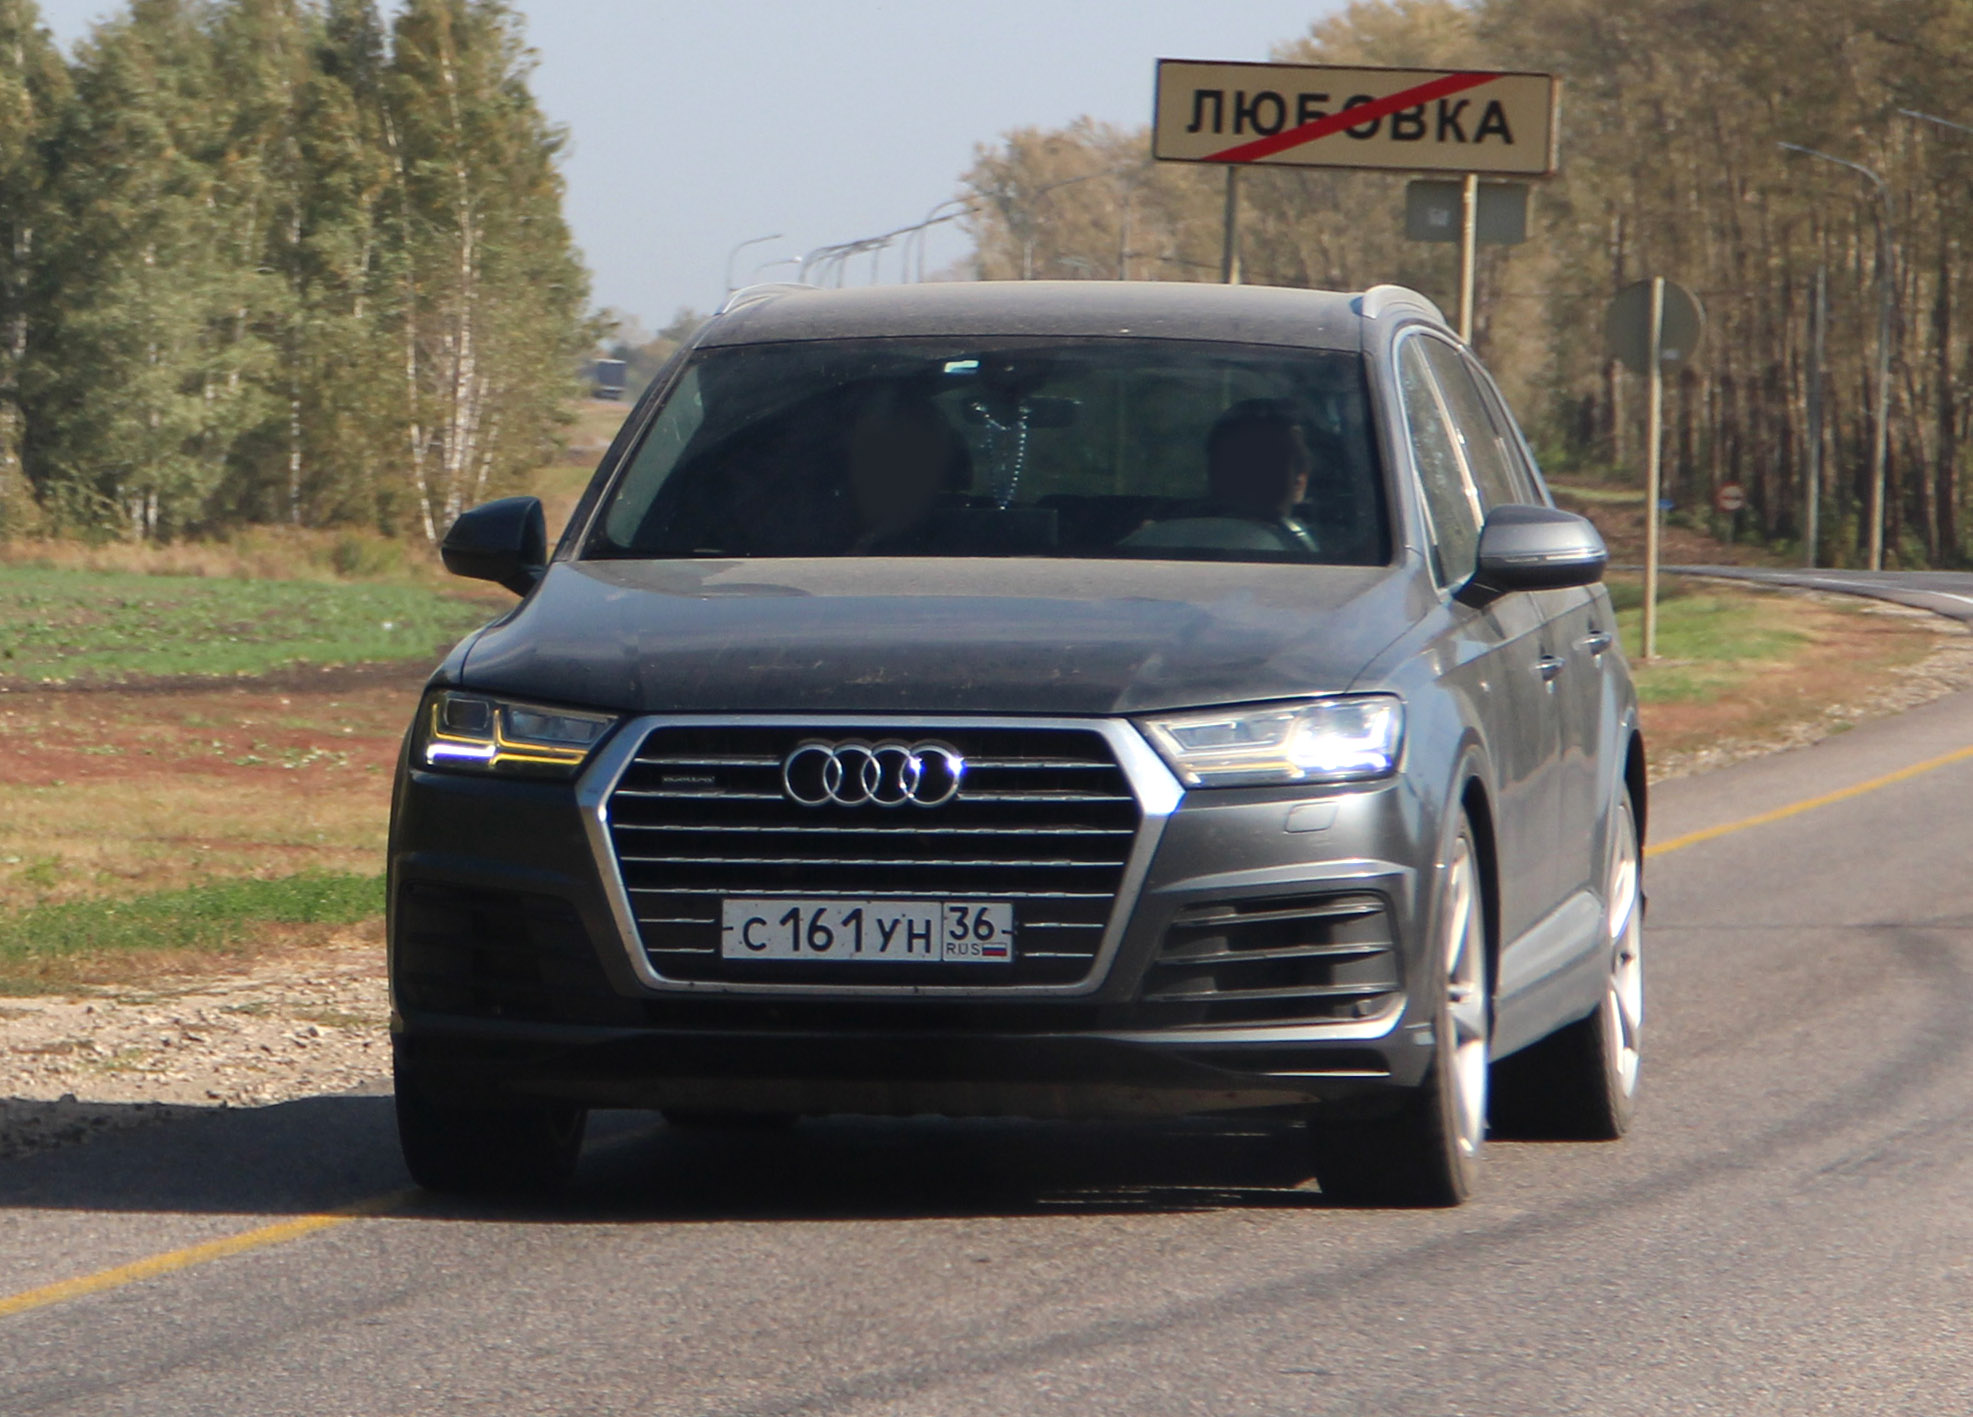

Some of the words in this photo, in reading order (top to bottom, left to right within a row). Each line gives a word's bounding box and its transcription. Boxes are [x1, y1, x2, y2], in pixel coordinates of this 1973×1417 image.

[1186, 88, 1514, 144] ЛЮБОВКА
[949, 906, 995, 941] 36
[946, 943, 981, 956] RUS
